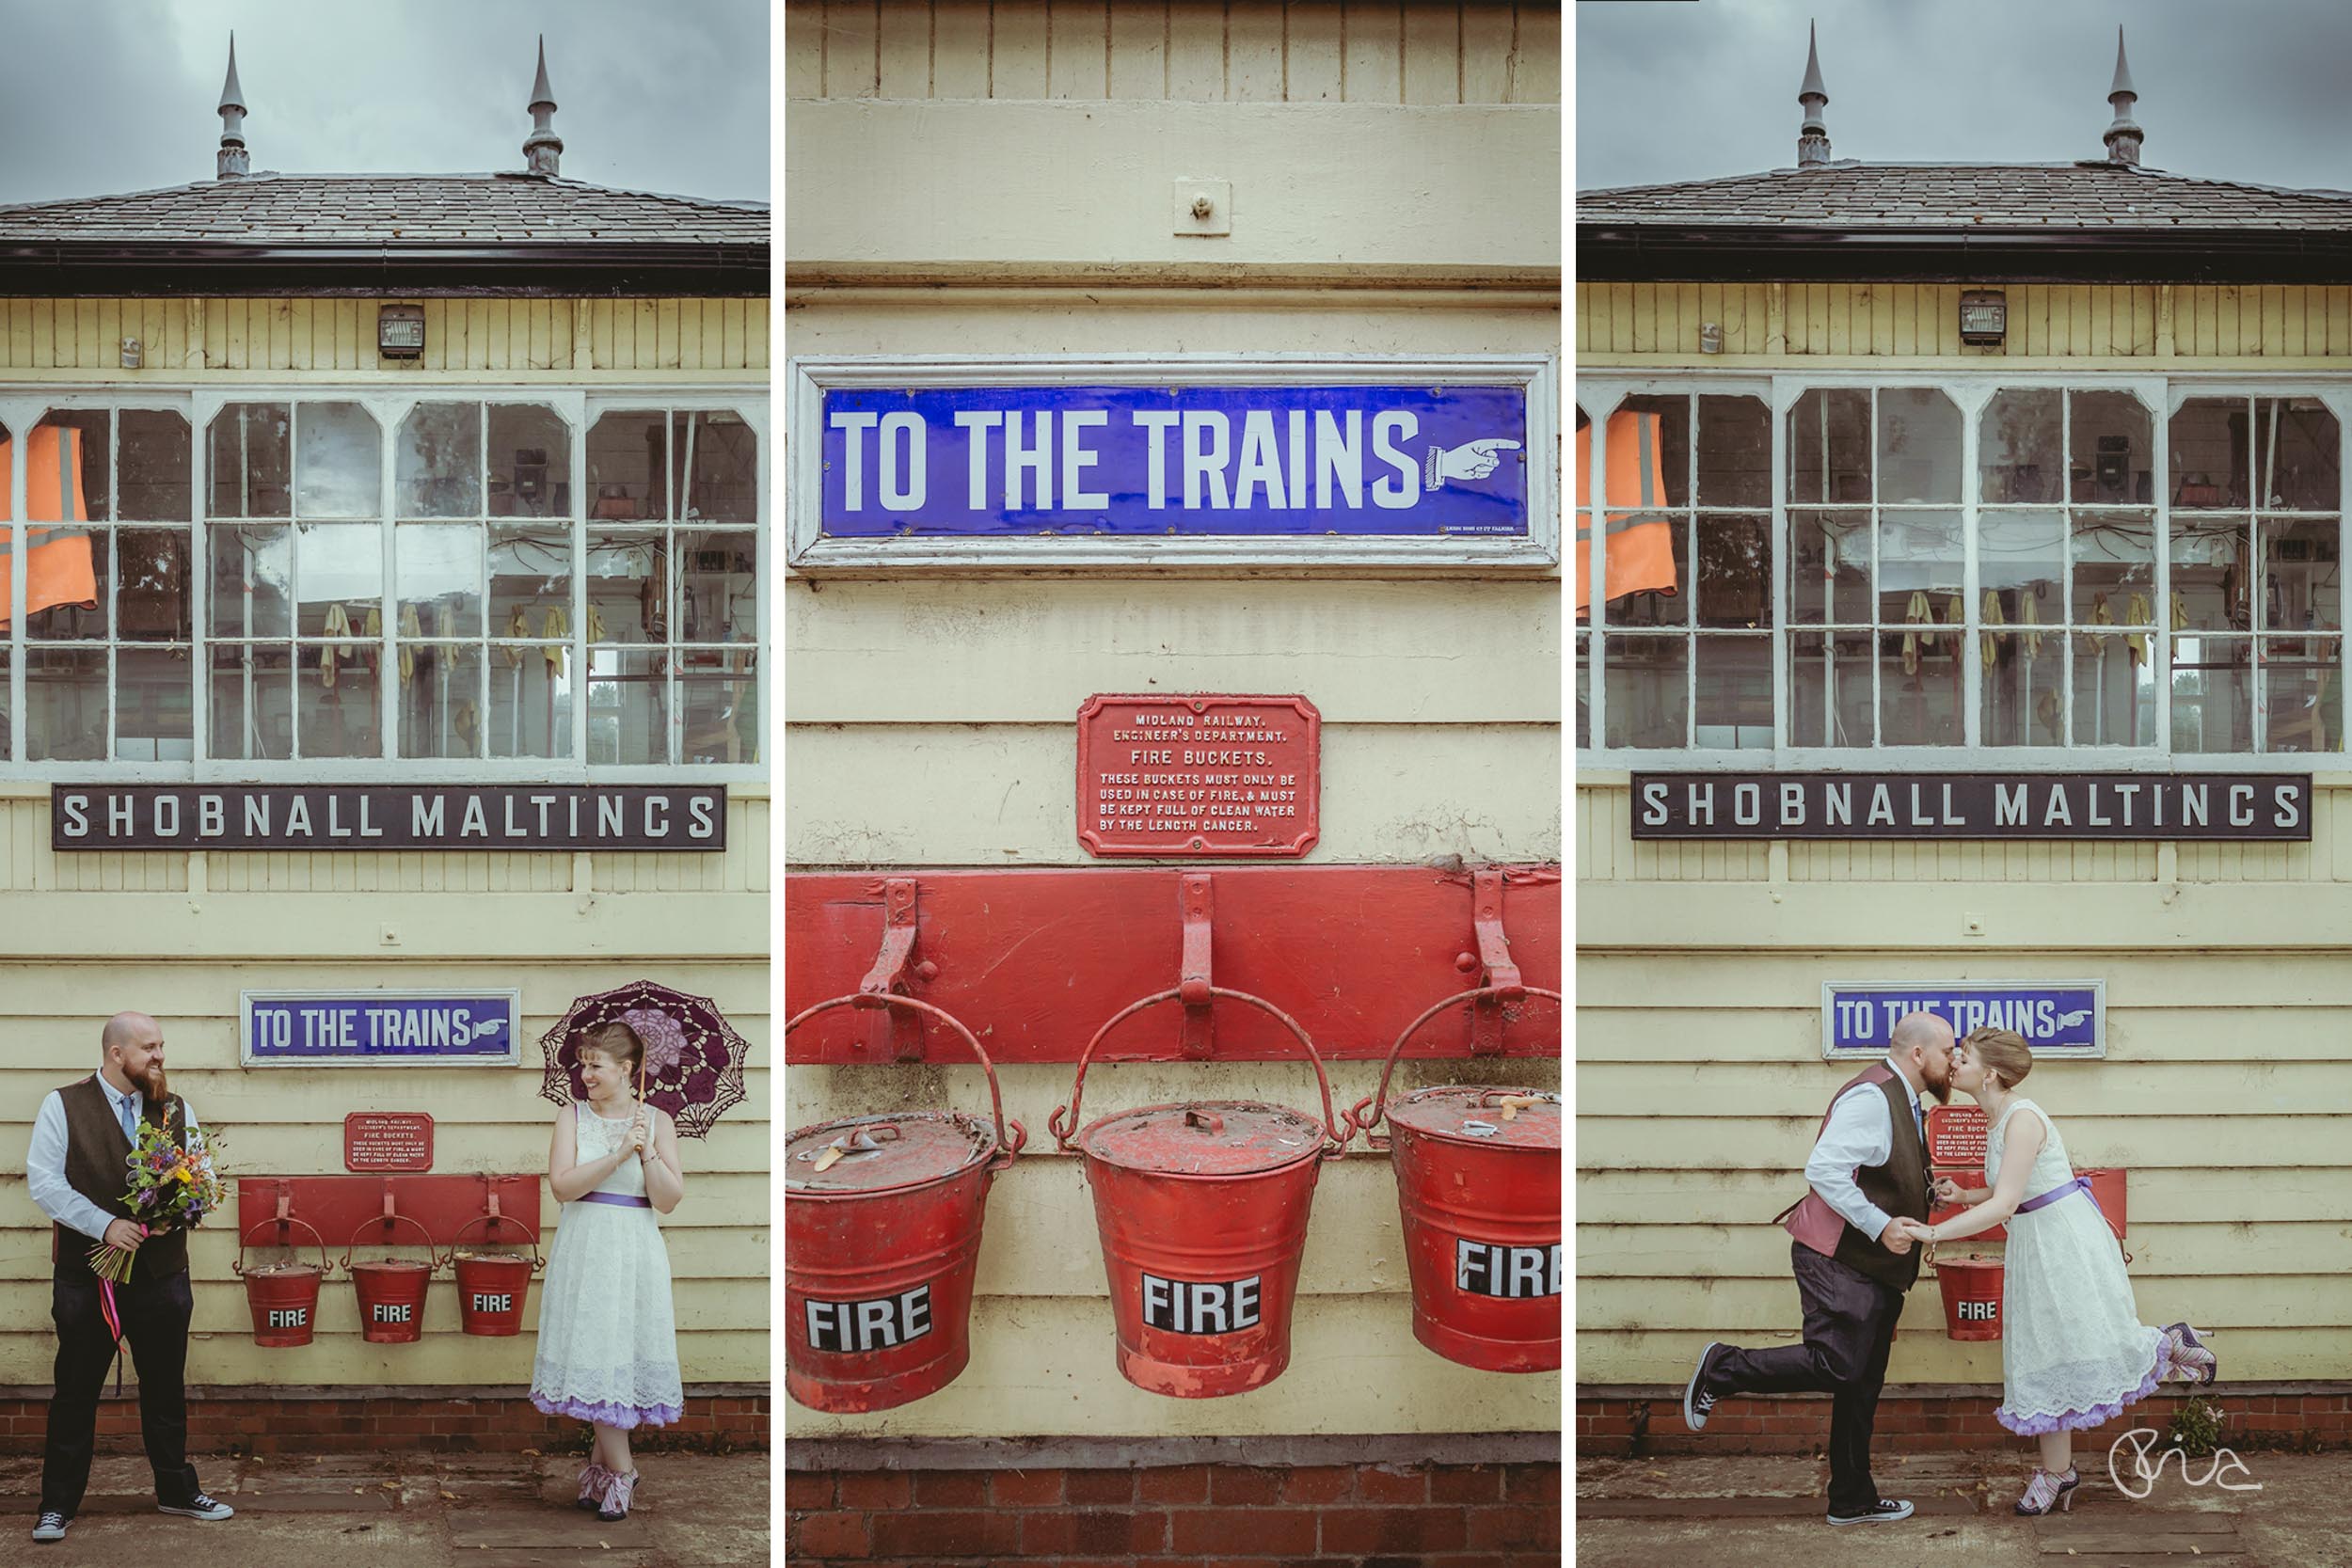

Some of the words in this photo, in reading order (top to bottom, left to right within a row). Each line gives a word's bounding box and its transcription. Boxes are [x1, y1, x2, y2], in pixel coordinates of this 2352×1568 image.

[830, 410, 928, 511] TO
[954, 410, 1110, 511] THE
[1133, 409, 1420, 510] TRAINS
[1136, 715, 1194, 726] MIDLAND
[1203, 715, 1265, 727] RAILWAY.
[1113, 728, 1189, 741] ENGINEER'S
[1194, 730, 1287, 742] DEPARTMENT.
[1131, 750, 1172, 765] FIRE
[1184, 750, 1272, 766] BUCKETS.
[1100, 773, 1139, 784] THESE
[1144, 773, 1200, 784] BUCKETS
[1205, 774, 1238, 784] MUST
[1243, 774, 1275, 785] ONLY
[1280, 775, 1295, 785] BE
[1100, 788, 1132, 800] USED
[1136, 789, 1150, 800] IN
[1153, 789, 1185, 800] CASE
[1189, 790, 1205, 800] OF
[1260, 791, 1295, 801] MUST
[1100, 803, 1116, 815] BE
[1120, 804, 1152, 816] KEPT
[1157, 805, 1187, 816] FULL
[1191, 805, 1206, 816] OF
[1211, 805, 1250, 816] CLEAN
[1254, 806, 1295, 817] WATER
[1643, 783, 1965, 827] SHOBNALL
[63, 794, 383, 837] SHOBNALL
[1100, 819, 1115, 831] BY
[1120, 819, 1143, 831] THE
[255, 1009, 292, 1047] TO
[300, 1009, 358, 1047] THE
[365, 1008, 471, 1047] TRAINS
[1836, 1000, 1874, 1039] TO
[473, 1293, 512, 1312] FIRE
[1143, 1275, 1260, 1334] FIRE
[1958, 1301, 1996, 1320] FIRE
[269, 1307, 307, 1327] FIRE
[373, 1304, 412, 1323] FIRE
[806, 1285, 931, 1353] FIRE
